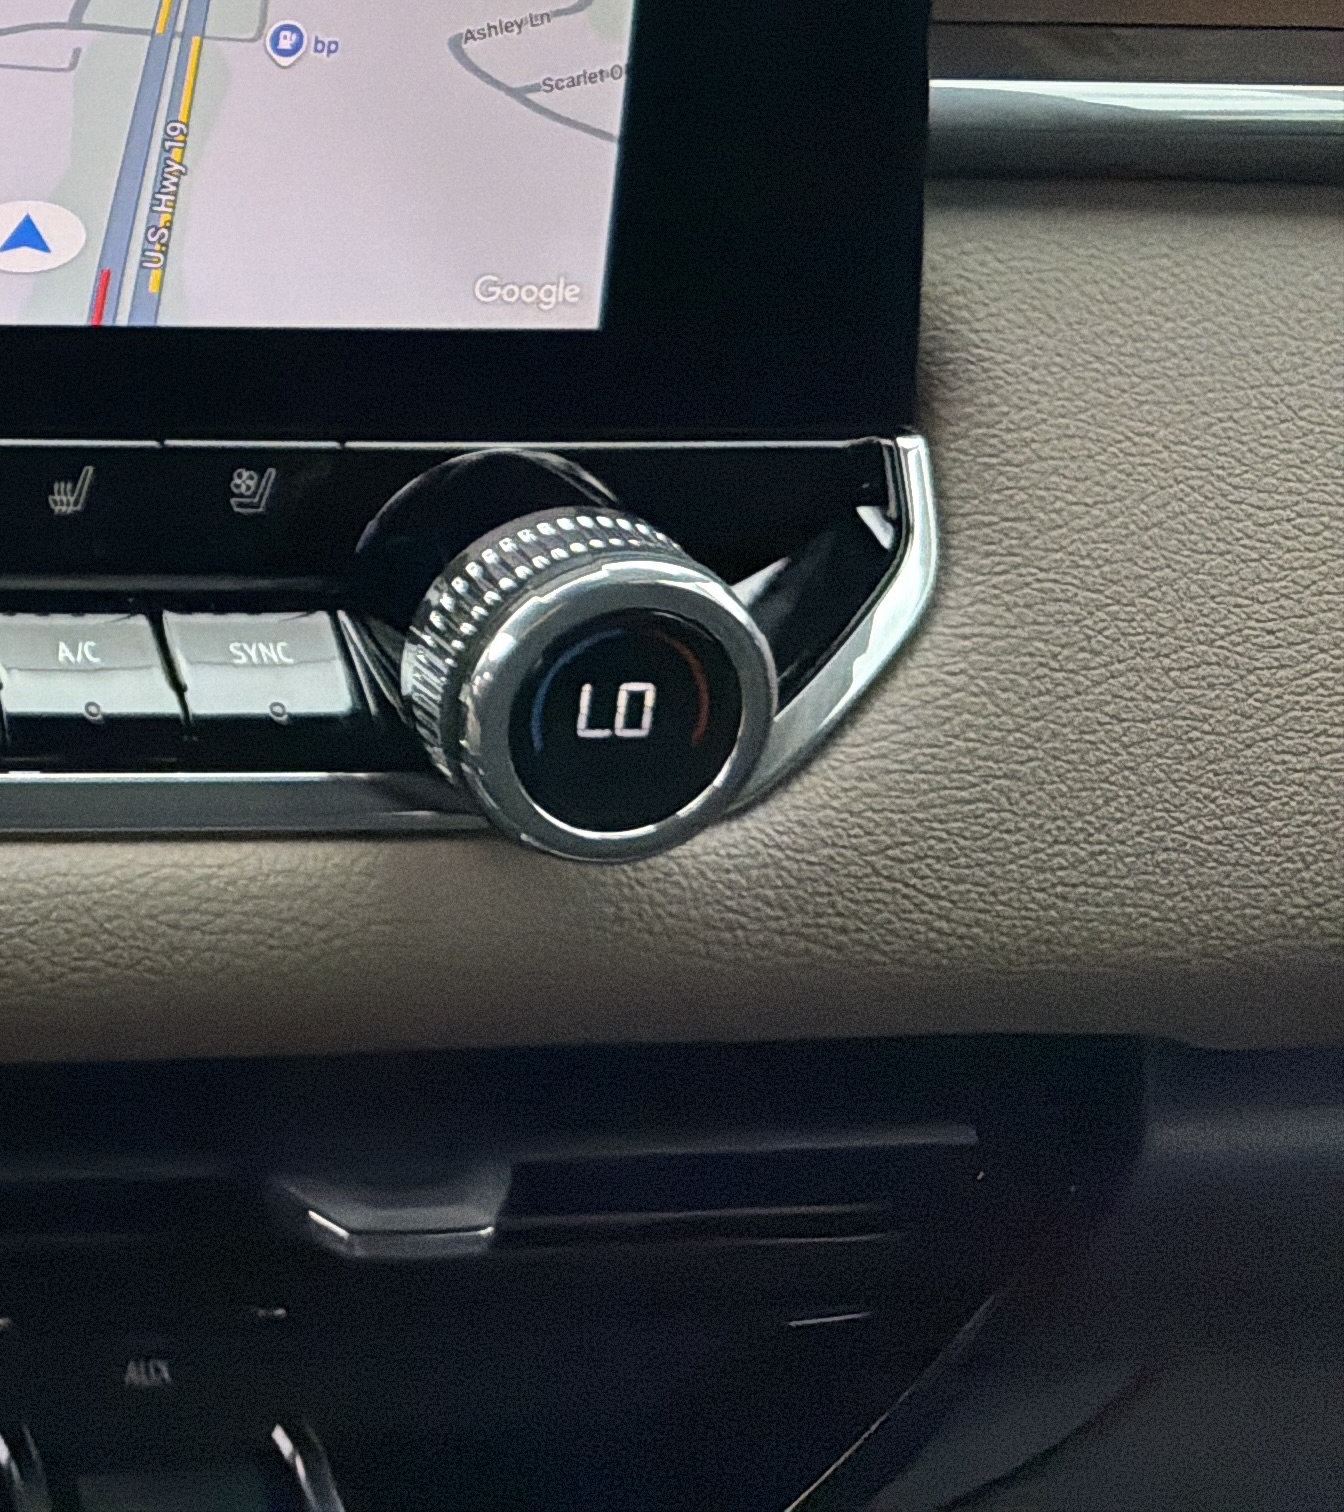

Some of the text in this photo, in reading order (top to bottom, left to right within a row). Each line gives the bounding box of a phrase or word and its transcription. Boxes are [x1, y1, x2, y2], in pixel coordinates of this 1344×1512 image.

[463, 11, 552, 45] Ashley Ln
[313, 35, 339, 57] bp
[541, 69, 606, 94] Scarlet
[143, 120, 188, 270] U.S. Hwy 19
[474, 274, 581, 310] Google
[57, 640, 101, 663] A/C
[229, 640, 295, 664] SYNC
